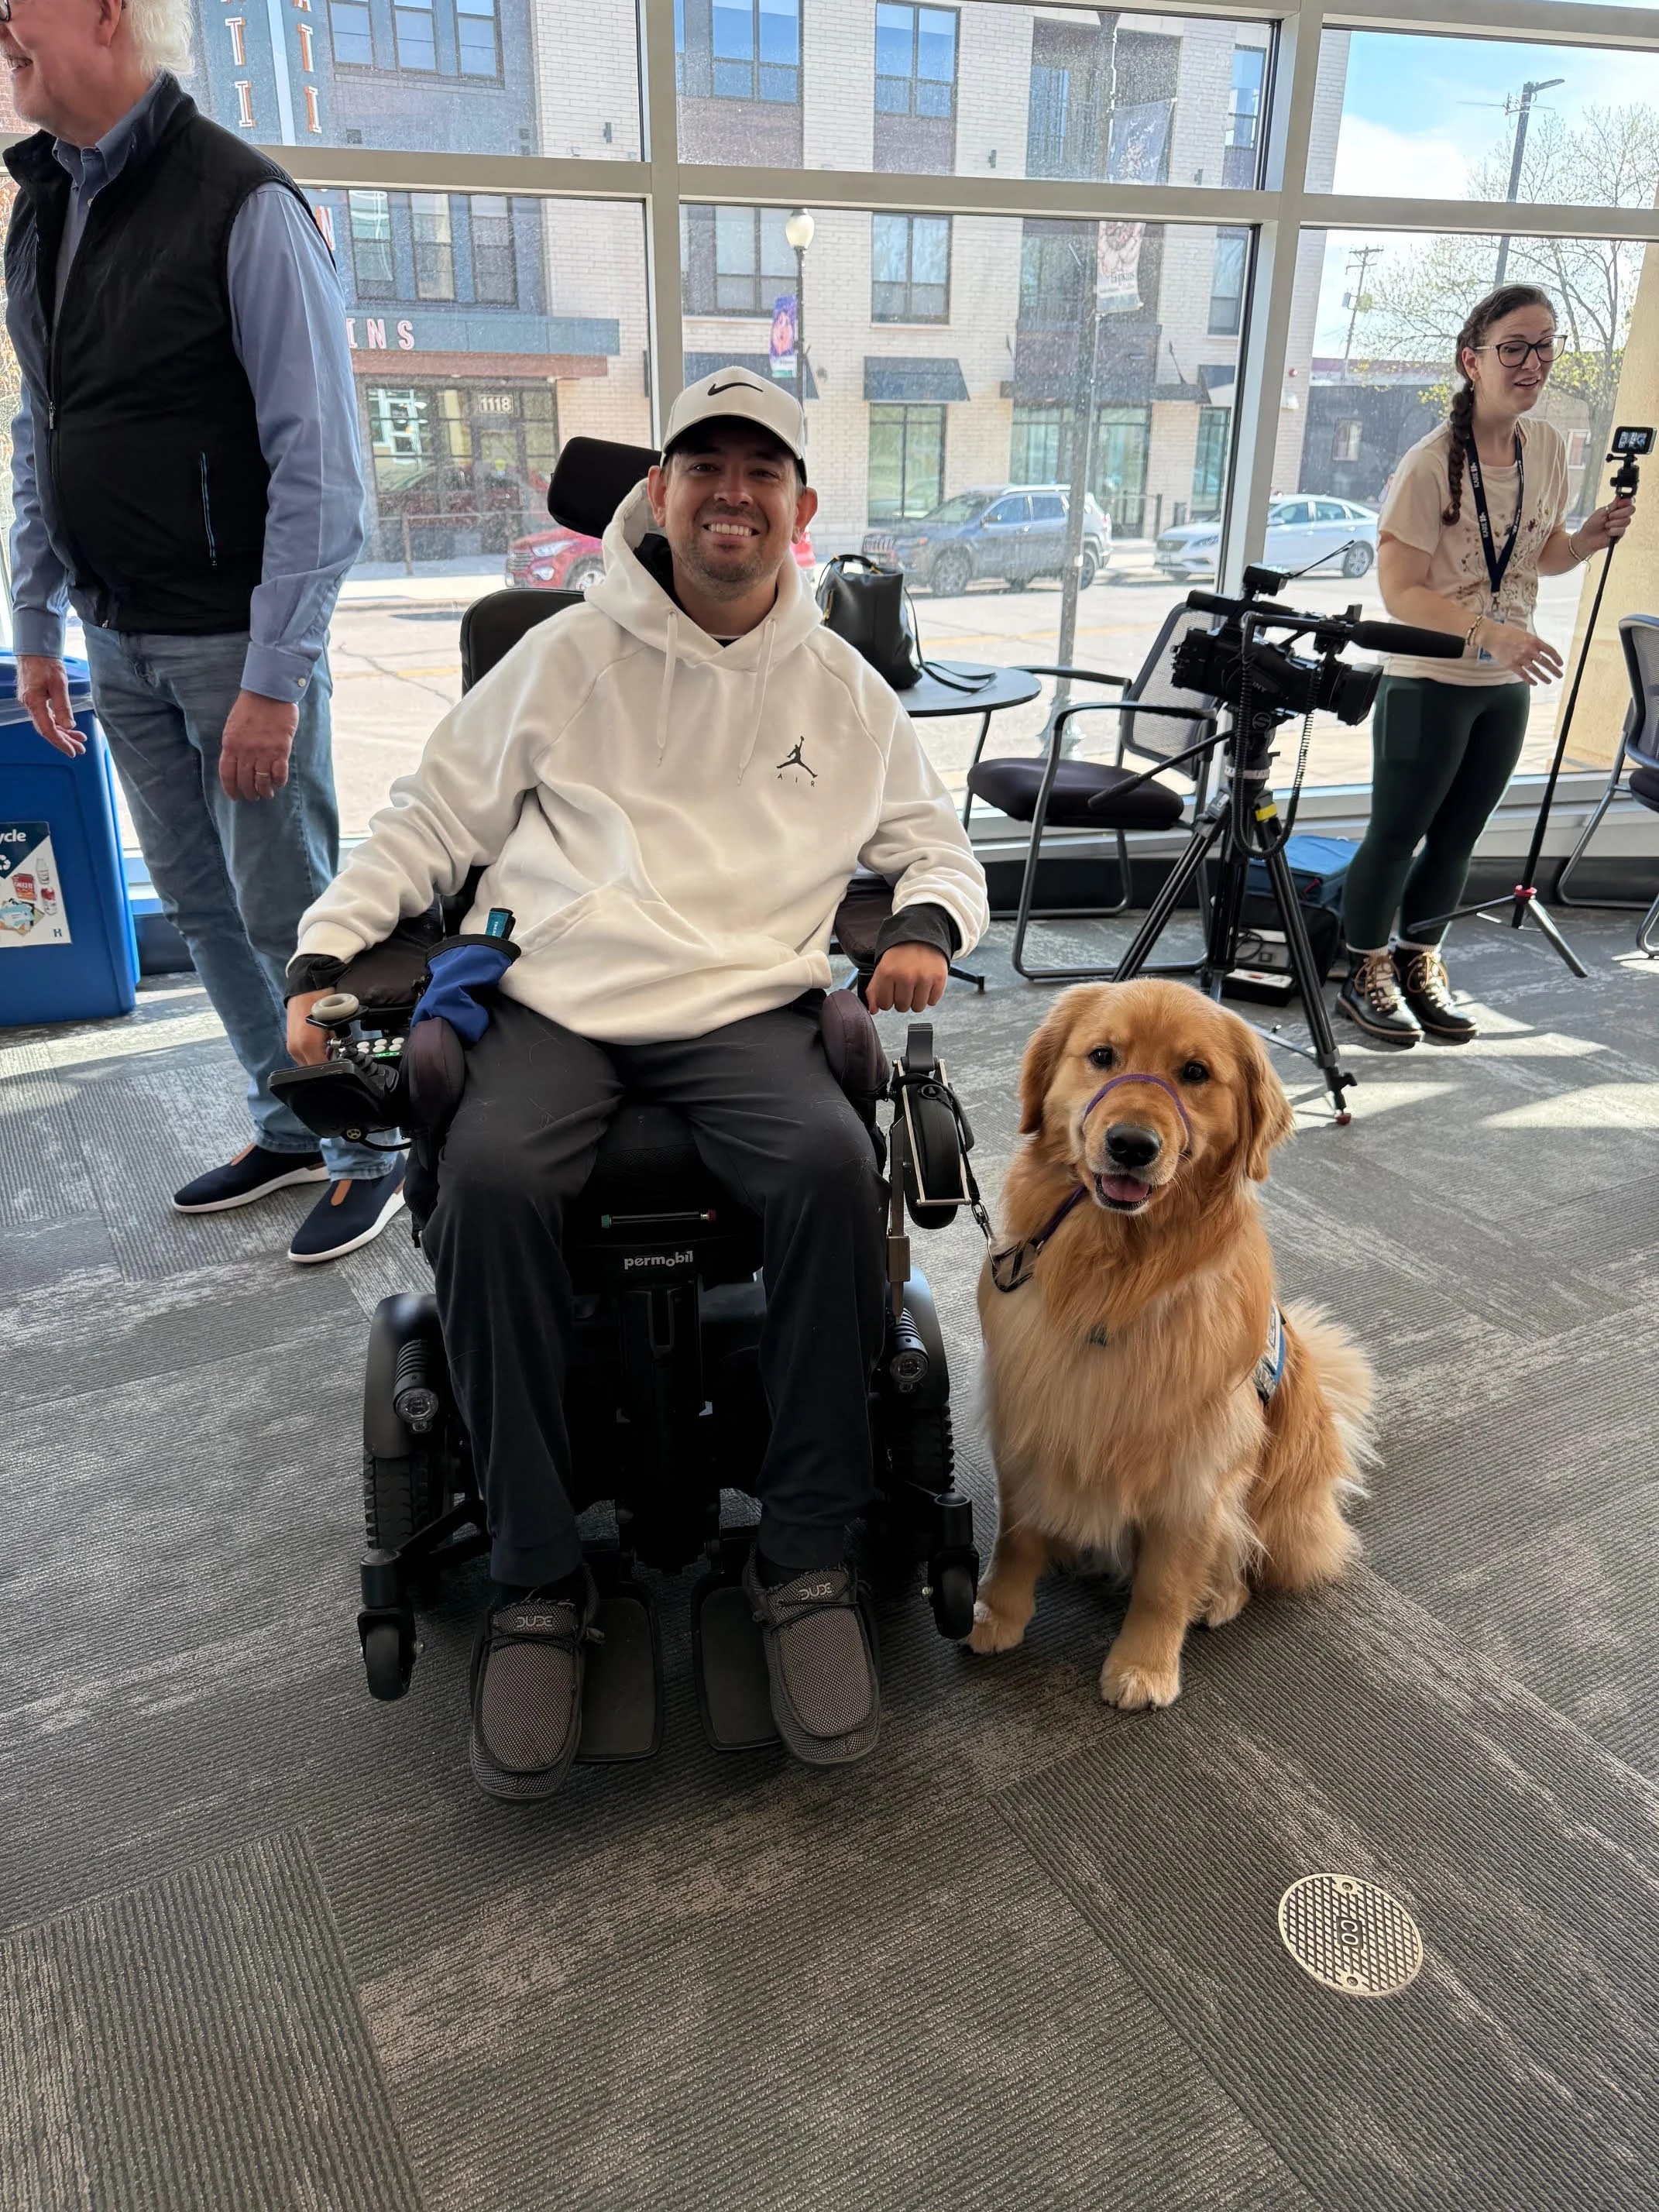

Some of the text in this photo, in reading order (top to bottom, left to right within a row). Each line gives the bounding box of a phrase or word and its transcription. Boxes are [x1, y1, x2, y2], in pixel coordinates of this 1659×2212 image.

[221, 0, 256, 128] TI
[481, 397, 512, 412] 1118
[778, 773, 815, 788] AIR
[53, 929, 63, 937] H
[624, 1251, 693, 1270] permobil
[799, 1582, 833, 1600] DUDE
[517, 1616, 553, 1628] DUDE
